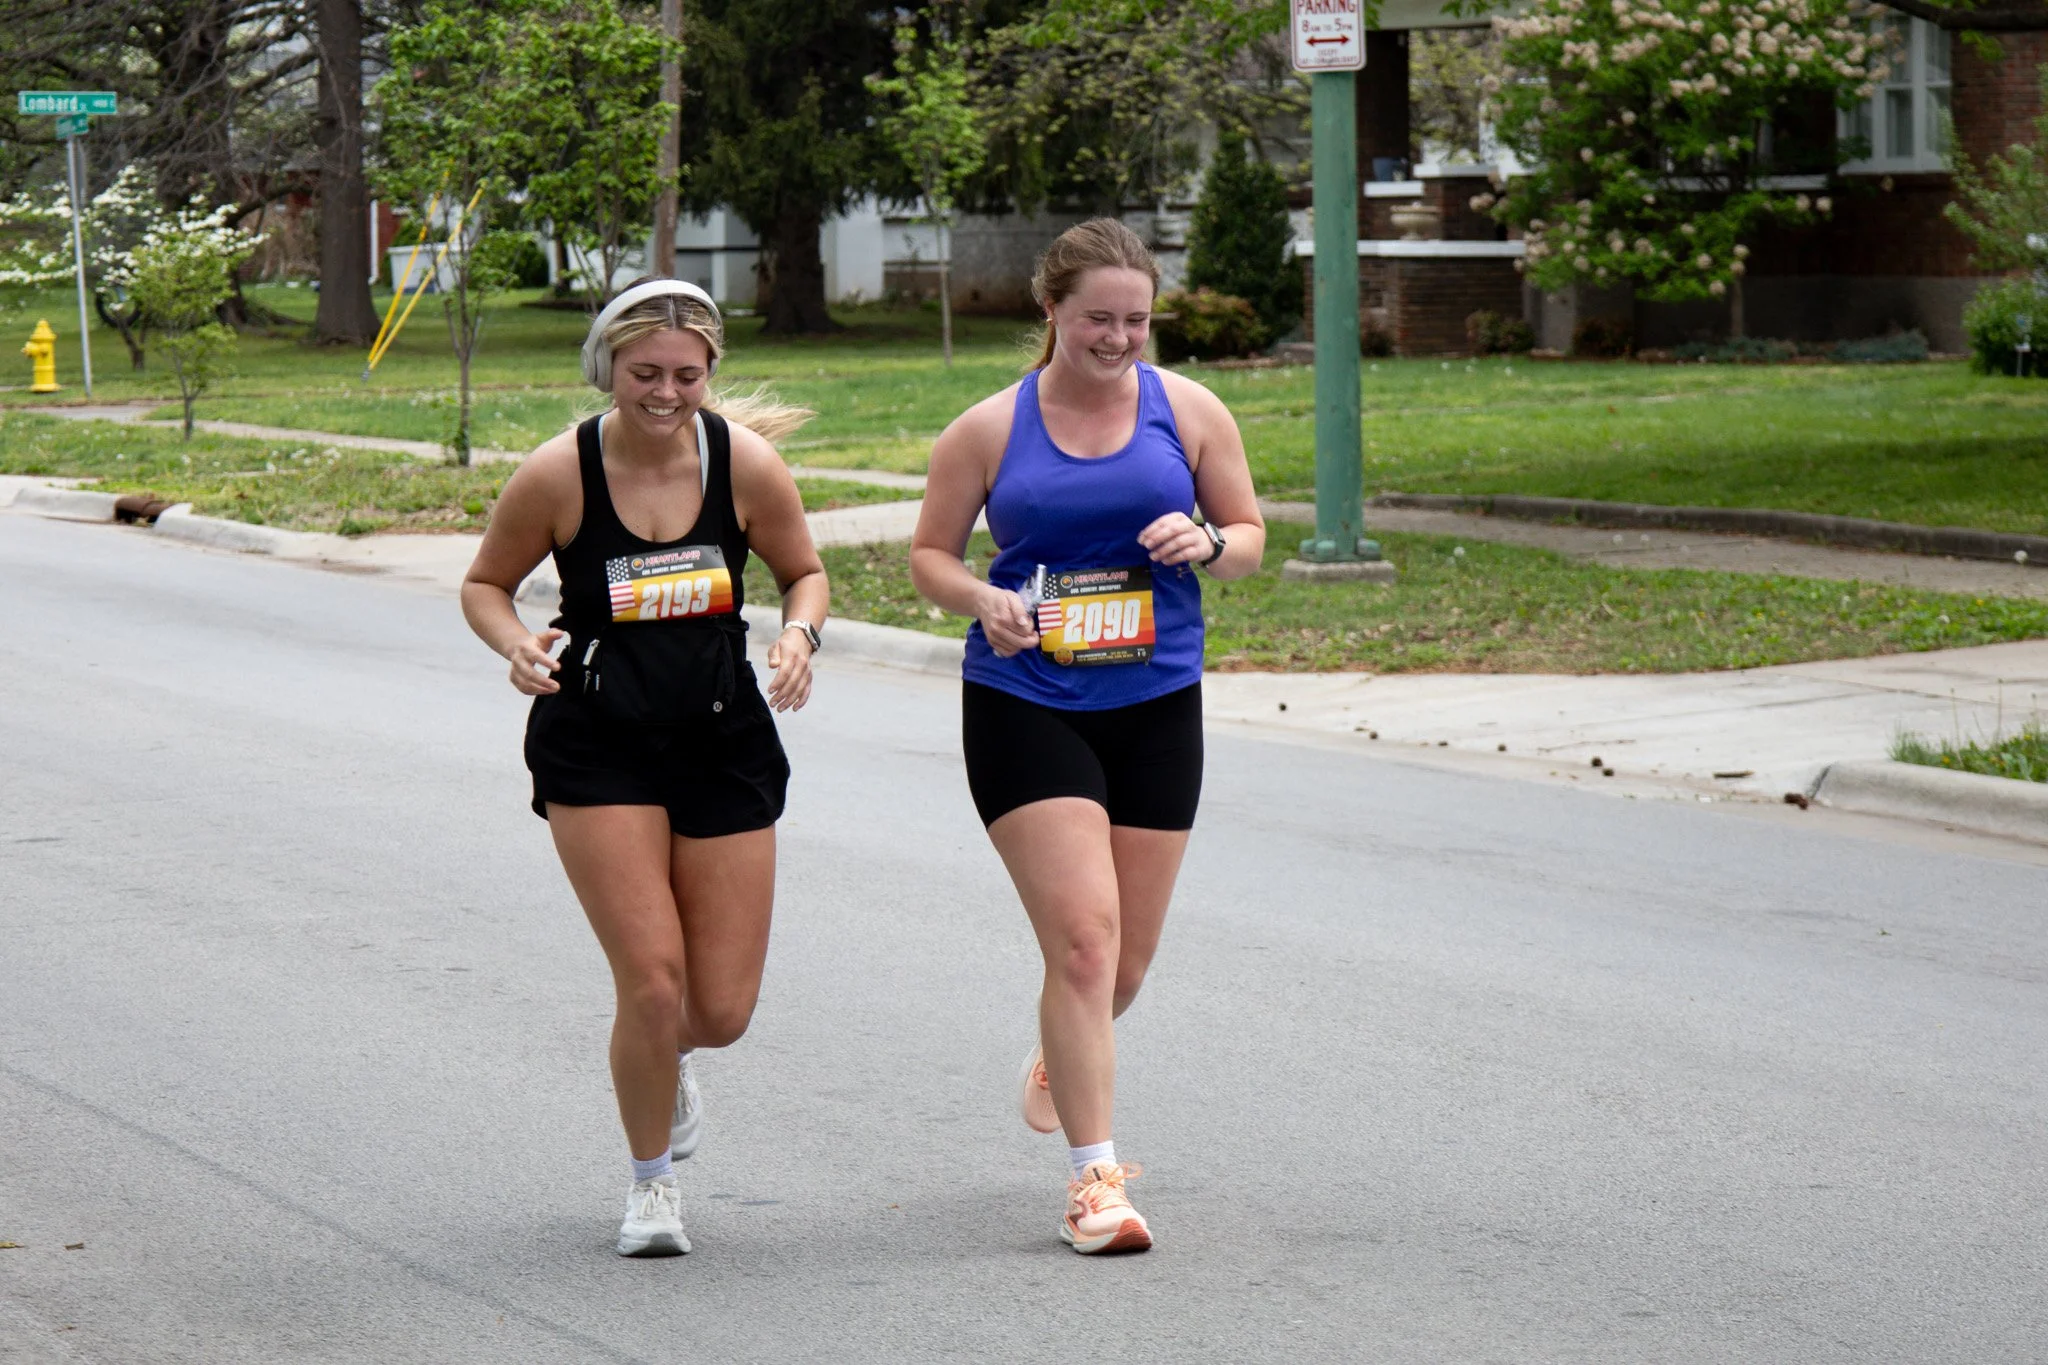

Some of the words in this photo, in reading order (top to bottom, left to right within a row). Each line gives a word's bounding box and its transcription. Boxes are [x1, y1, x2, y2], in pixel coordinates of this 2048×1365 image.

[1296, 0, 1356, 15] PARKING
[20, 95, 78, 112] Lombard
[644, 550, 701, 567] HEARTLAND
[1073, 570, 1129, 585] HEARTLAND
[638, 576, 713, 621] 2193
[1063, 599, 1141, 644] 2090
